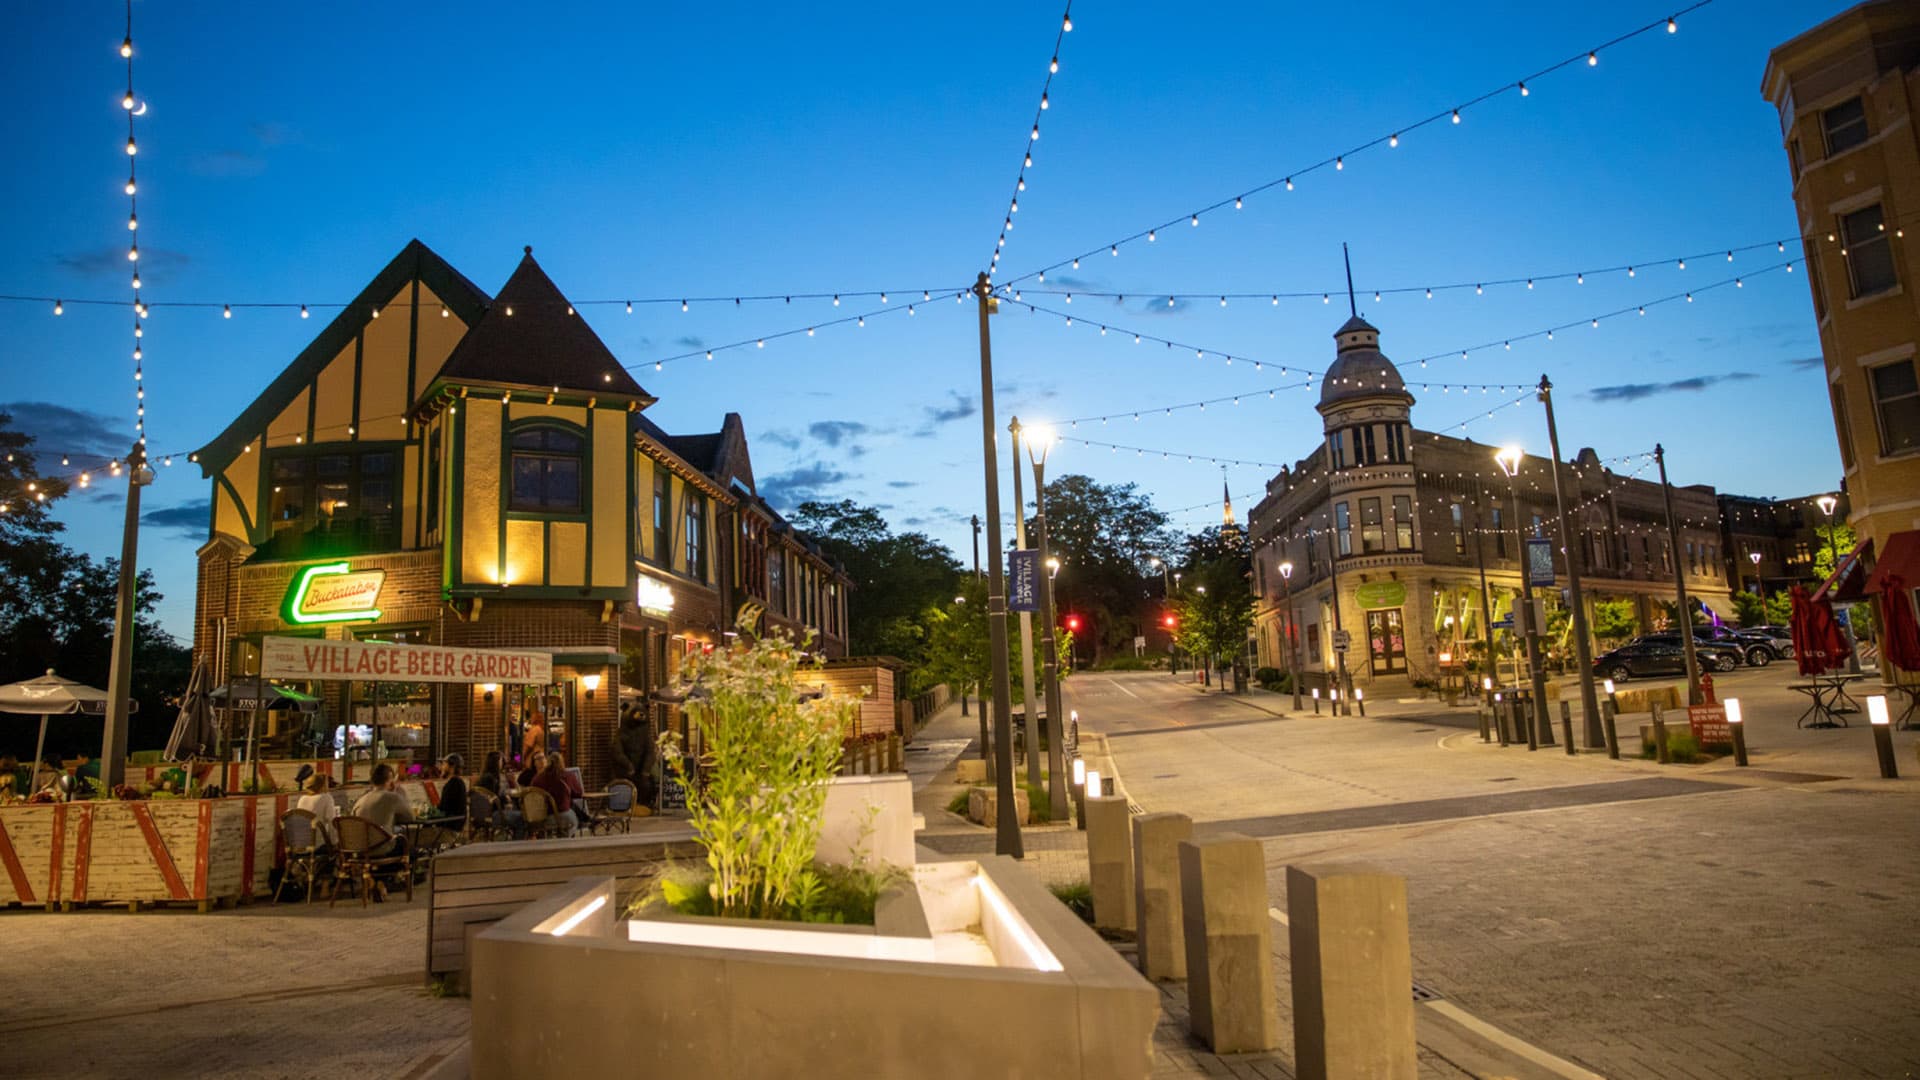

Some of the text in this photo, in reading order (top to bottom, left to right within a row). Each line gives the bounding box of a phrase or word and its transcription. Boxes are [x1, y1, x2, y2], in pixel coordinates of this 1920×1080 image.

[1024, 559, 1032, 604] VILLAGE
[303, 644, 532, 679] VILLAGE BEER GARDEN
